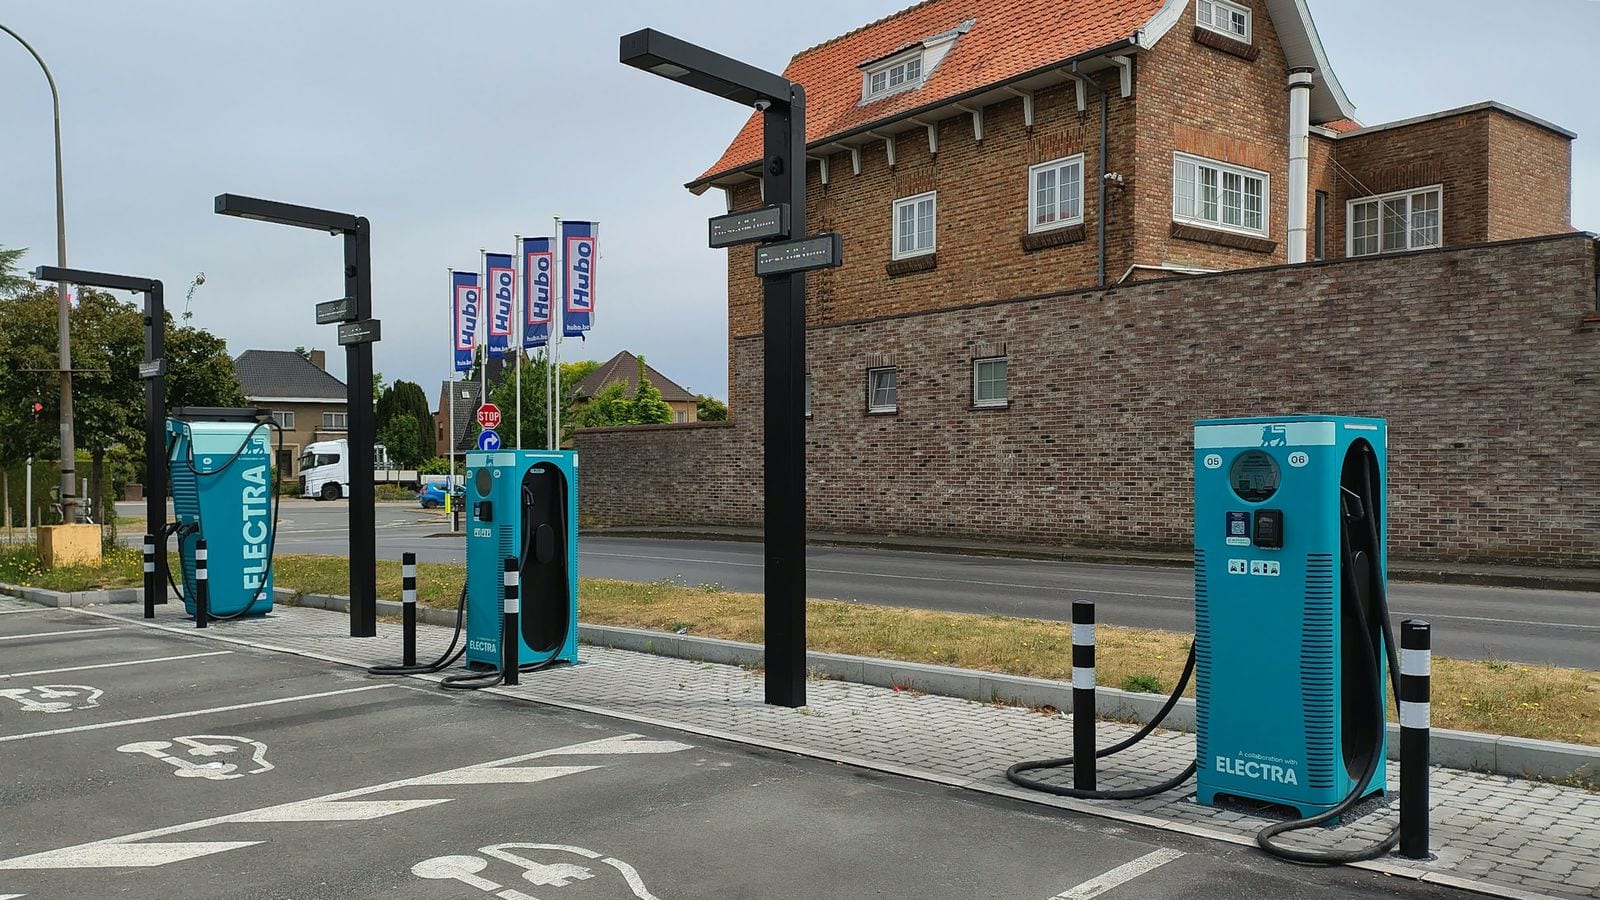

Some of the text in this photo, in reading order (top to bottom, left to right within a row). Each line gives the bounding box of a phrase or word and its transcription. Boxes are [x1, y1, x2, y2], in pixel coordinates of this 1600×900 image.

[533, 257, 550, 319] Hubo
[573, 242, 591, 308] Hubo
[462, 290, 477, 345] Hubo
[495, 272, 512, 331] Hubo
[478, 411, 499, 421] STOP
[1291, 456, 1305, 464] 06
[242, 465, 268, 590] ELECTRA
[469, 640, 496, 653] ELECTRA
[1216, 756, 1298, 786] ELECTRA
[1244, 752, 1283, 763] collaboration
